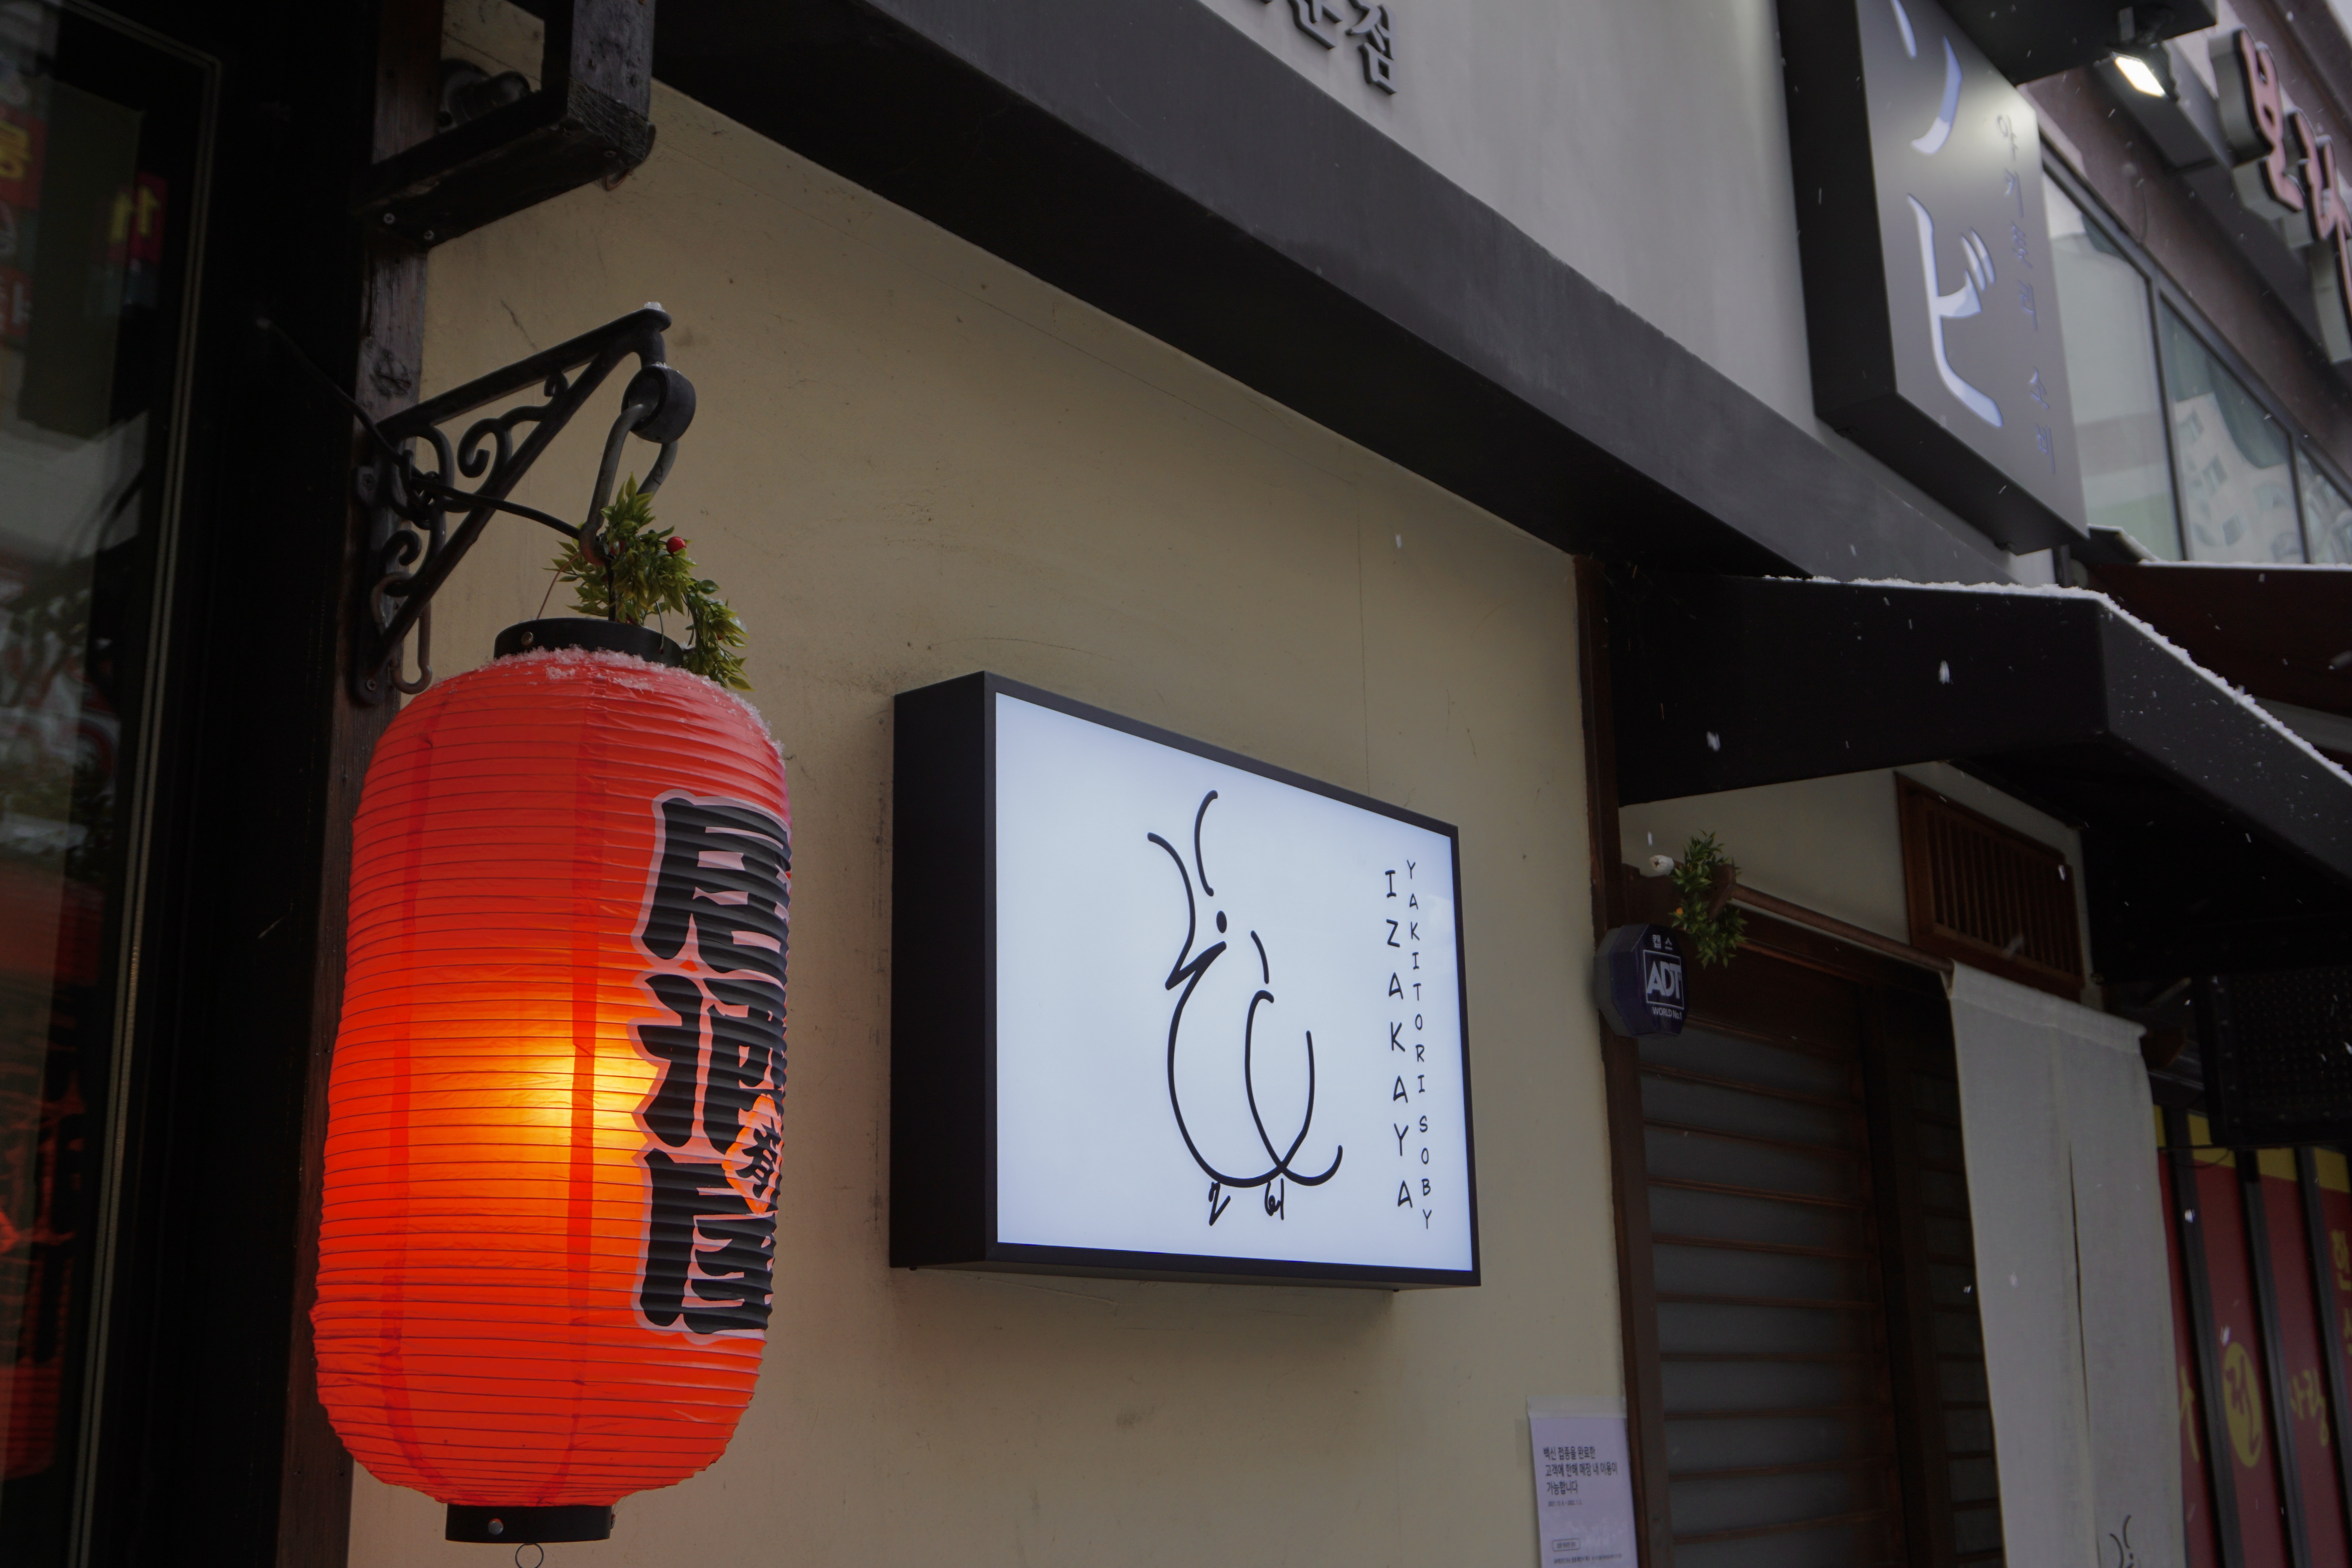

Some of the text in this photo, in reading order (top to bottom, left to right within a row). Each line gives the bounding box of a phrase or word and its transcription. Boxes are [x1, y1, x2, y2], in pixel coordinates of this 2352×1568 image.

[1647, 960, 1682, 1000] ADT
[1652, 1006, 1682, 1020] WORLD No.1
[1385, 869, 1412, 1208] IZAKAYA
[1406, 859, 1432, 1230] YAKITORI SOBY
[1543, 1446, 1596, 1460] 백신 접종을 완료한
[1545, 1461, 1618, 1477] 고객에 한해 매장 내 이용이
[1547, 1480, 1578, 1495] 가능합니다
